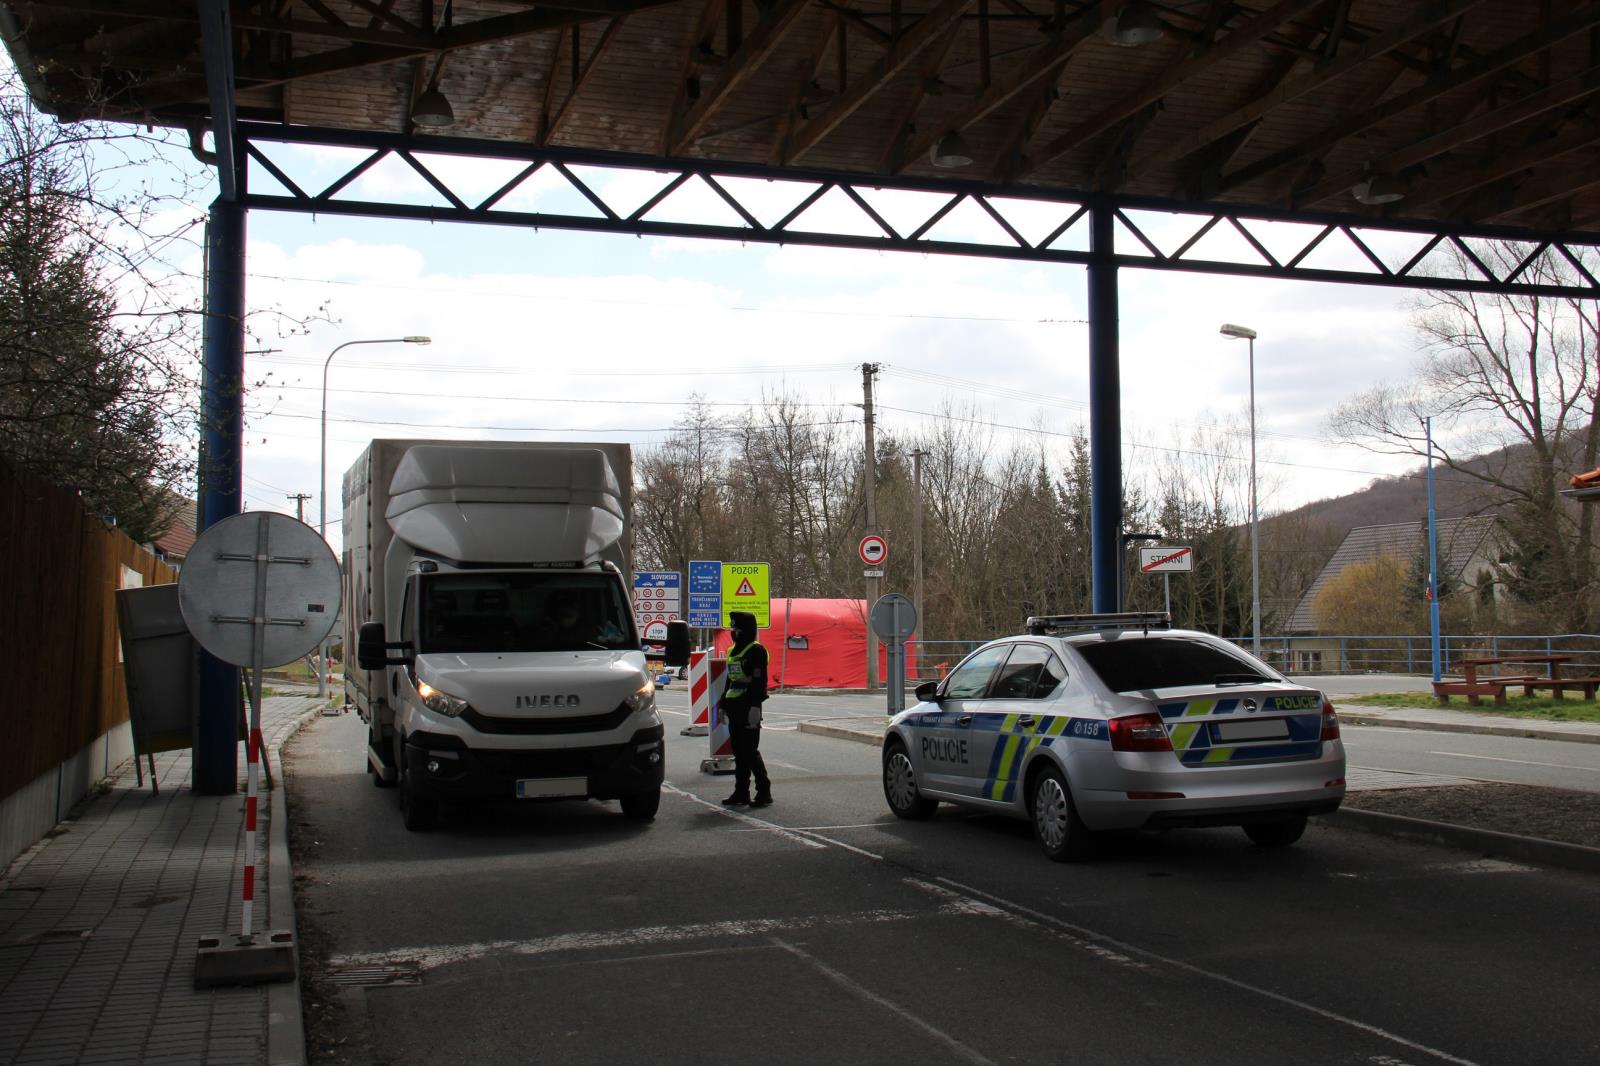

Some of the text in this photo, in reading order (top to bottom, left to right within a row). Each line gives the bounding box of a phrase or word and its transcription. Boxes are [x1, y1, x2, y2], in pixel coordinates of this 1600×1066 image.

[731, 566, 759, 575] POZOR
[515, 695, 580, 708] IVECO
[1274, 696, 1318, 710] POLICIE
[1083, 722, 1099, 736] 158
[921, 737, 968, 764] POLICIE
